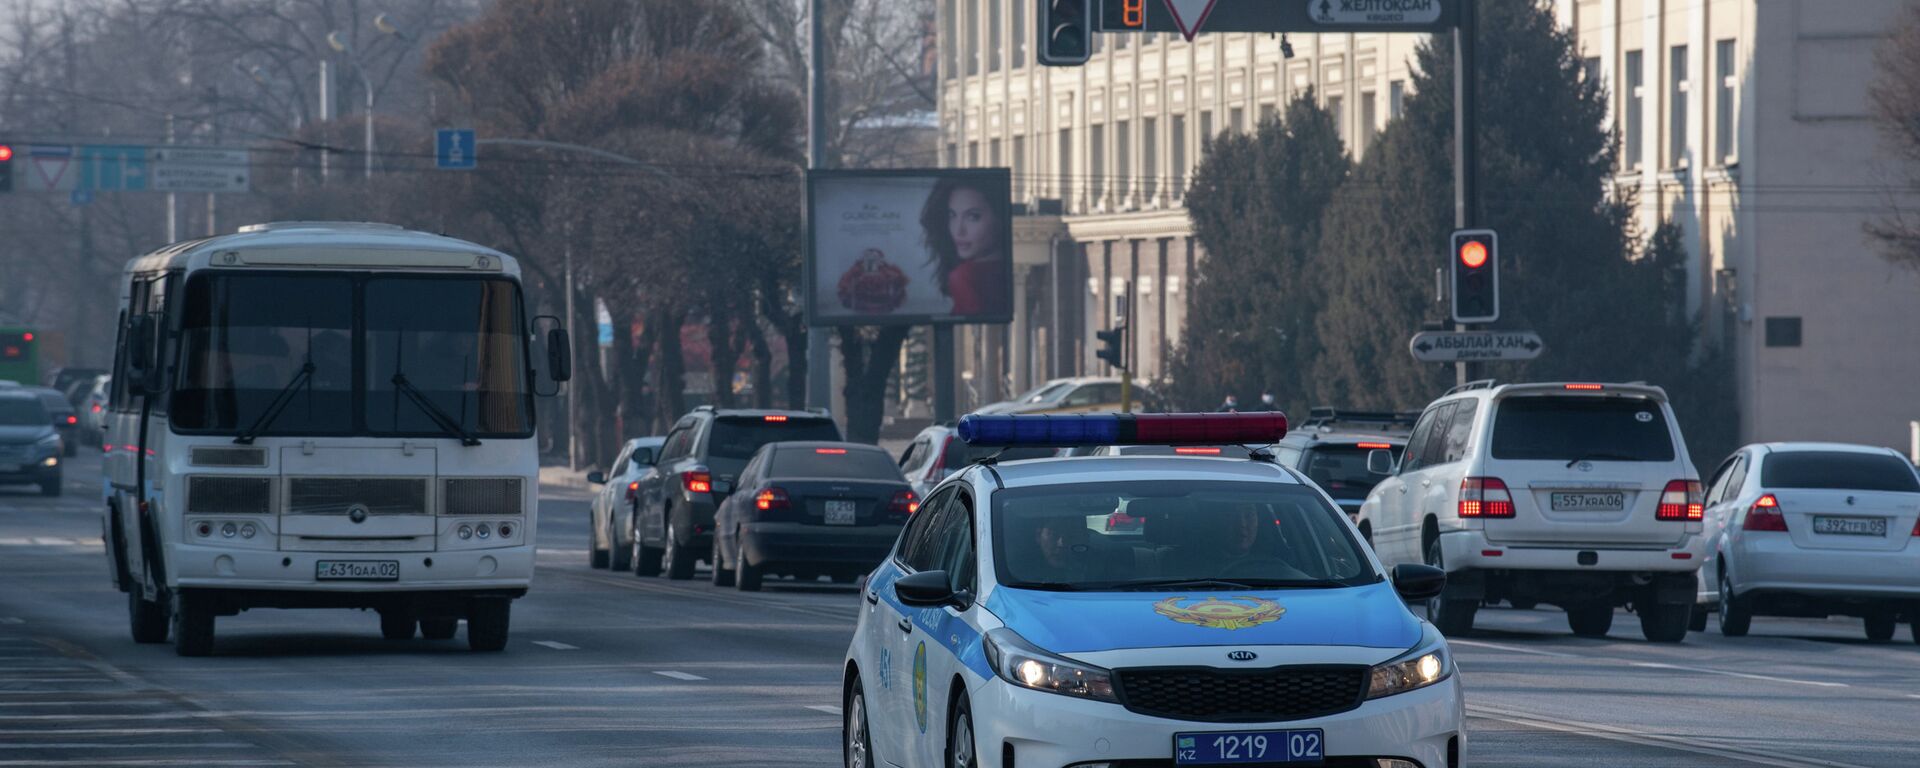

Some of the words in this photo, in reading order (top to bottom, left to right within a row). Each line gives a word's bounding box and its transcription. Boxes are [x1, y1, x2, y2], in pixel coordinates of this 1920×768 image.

[1435, 335, 1493, 349] АБЫЛАЙ
[1497, 335, 1524, 348] ХАН
[1607, 495, 1620, 506] 06
[381, 563, 397, 576] 02
[1231, 651, 1254, 660] KIA
[1179, 750, 1196, 761] KZ
[1213, 735, 1268, 759] 1219
[1290, 733, 1320, 758] 02
